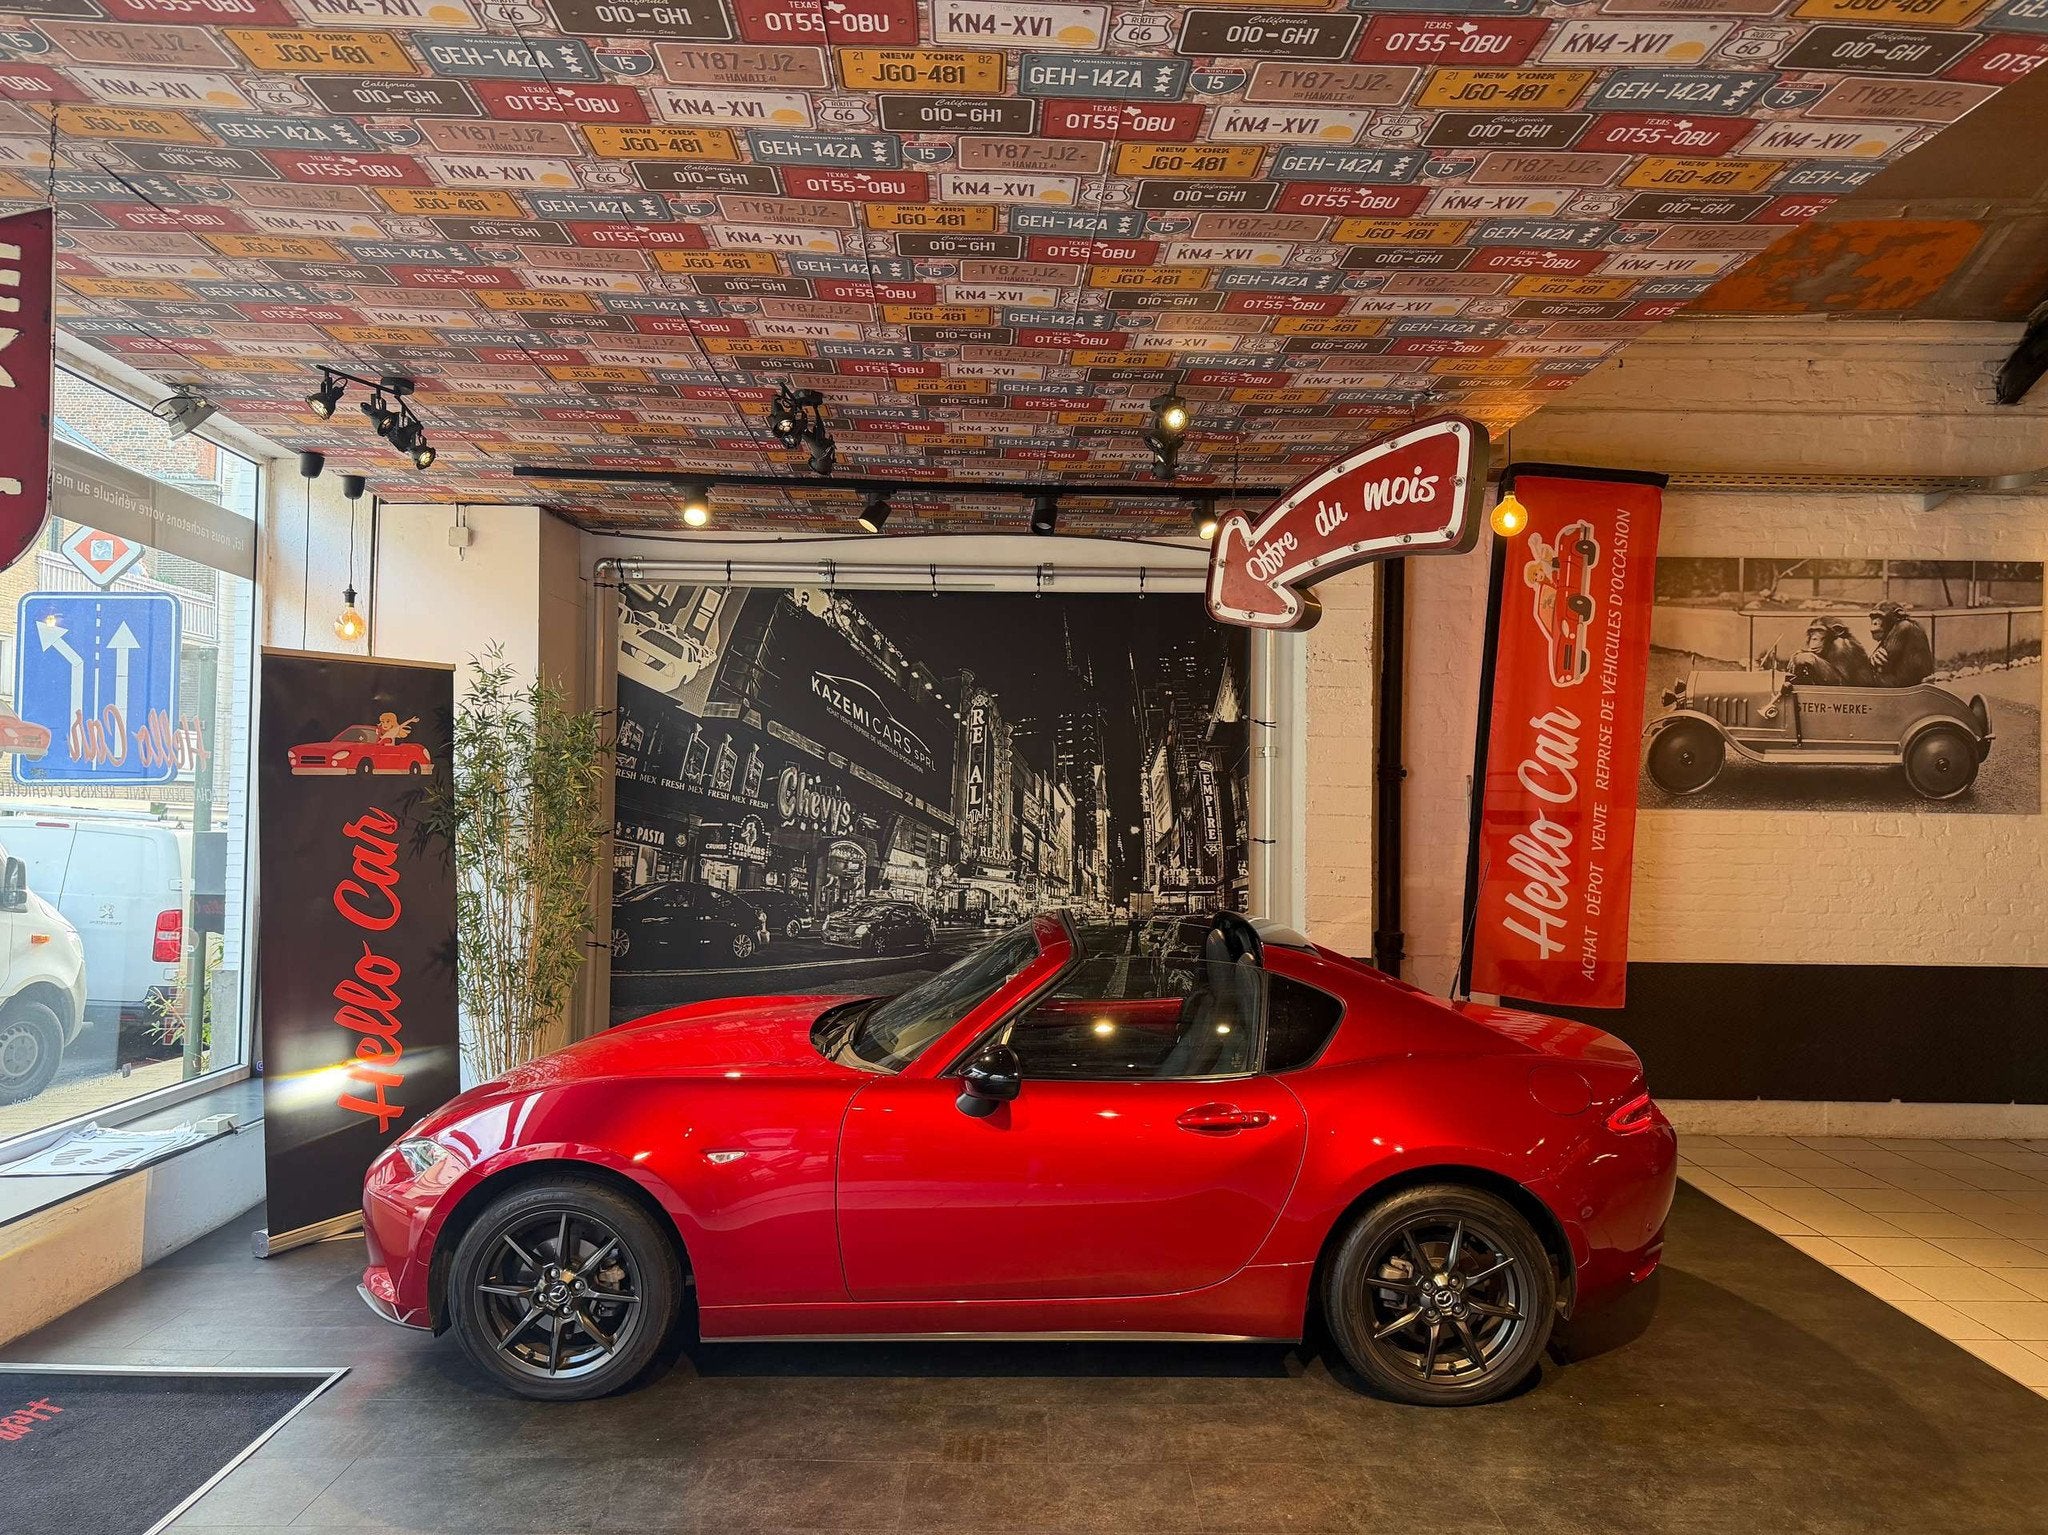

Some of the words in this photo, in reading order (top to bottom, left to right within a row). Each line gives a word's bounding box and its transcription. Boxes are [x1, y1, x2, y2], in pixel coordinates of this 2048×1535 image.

[498, 6, 524, 21] 66
[788, 0, 818, 8] TEXAS
[1247, 15, 1308, 26] California
[1424, 21, 1453, 29] TEXAS
[266, 32, 304, 40] NEW
[309, 33, 357, 42] YORK
[1128, 27, 1152, 41] 66
[1866, 32, 1928, 42] California
[430, 46, 554, 68] GEH-142A
[1735, 42, 1765, 55] 66
[614, 56, 636, 70] 15
[361, 80, 416, 89] California
[1030, 67, 1142, 88] GEH-142A
[1206, 76, 1226, 89] 15
[1517, 73, 1557, 81] YORK
[1604, 81, 1723, 101] GEH-142A
[1775, 90, 1802, 104] 15
[935, 99, 988, 108] California
[833, 109, 855, 121] 66
[1491, 116, 1545, 124] California
[1381, 126, 1404, 137] 66
[1437, 163, 1457, 174] 15
[1315, 500, 1349, 537] du
[1363, 465, 1440, 512] mois
[1608, 508, 1632, 606] D'OCCASION
[1600, 611, 1622, 695] VÉHICULES
[1600, 698, 1614, 720] DE
[914, 749, 937, 772] SPRL
[1517, 706, 1581, 804] Car
[1594, 723, 1613, 791] REPRISE
[639, 774, 657, 785] MEX
[661, 778, 685, 791] FRESH
[708, 789, 729, 801] FRESH
[749, 799, 769, 810] FRESH
[777, 766, 851, 835] Chevys
[1202, 773, 1217, 841] EMPIRE
[1590, 802, 1608, 851] VENTE
[637, 827, 665, 846] PASTA
[333, 806, 402, 932] Car
[1501, 807, 1573, 960] Hello
[1584, 861, 1604, 916] DÉPOT
[1581, 925, 1599, 981] ACHAT
[333, 940, 406, 1133] Hello
